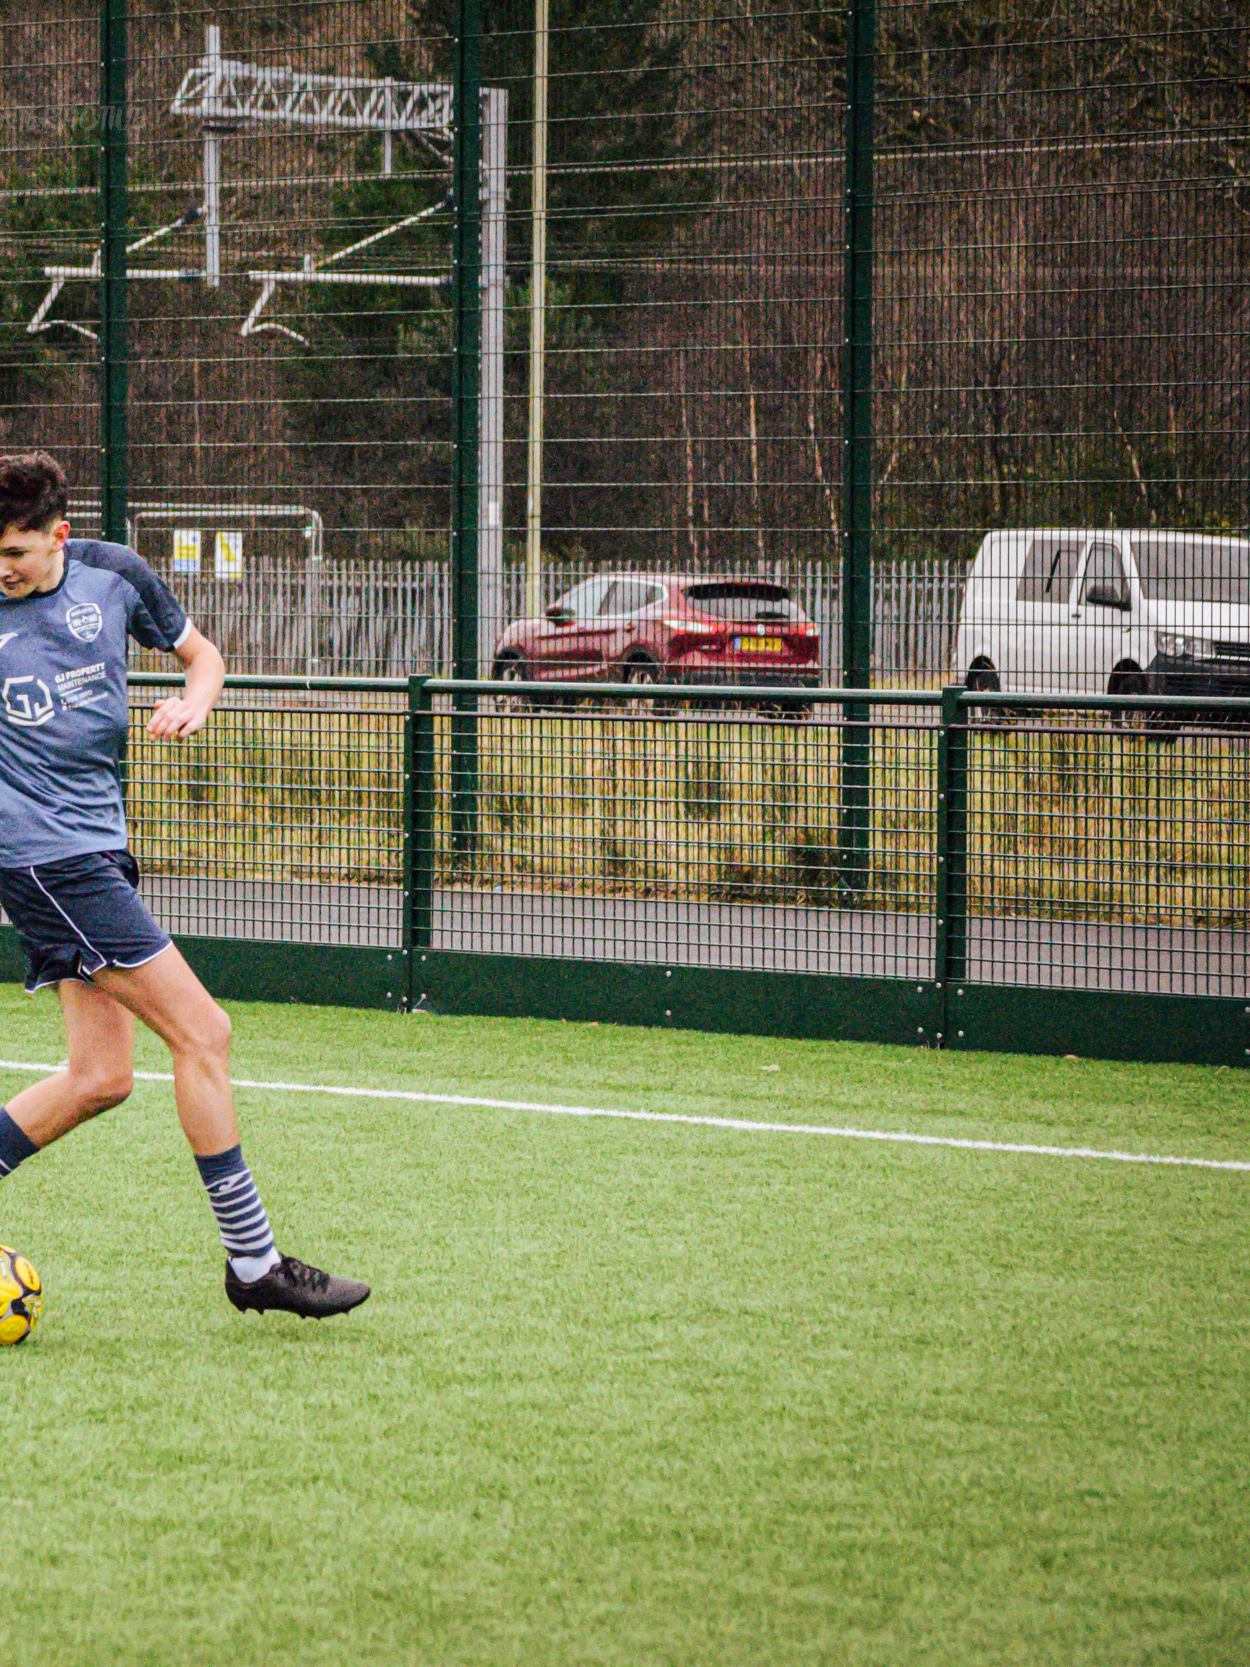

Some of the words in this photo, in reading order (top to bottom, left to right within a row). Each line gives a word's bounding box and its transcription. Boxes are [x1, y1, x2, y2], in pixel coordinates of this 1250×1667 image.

[54, 672, 65, 684] GJ
[65, 662, 106, 680] PROPERTY
[57, 670, 107, 691] MAINTENANCE
